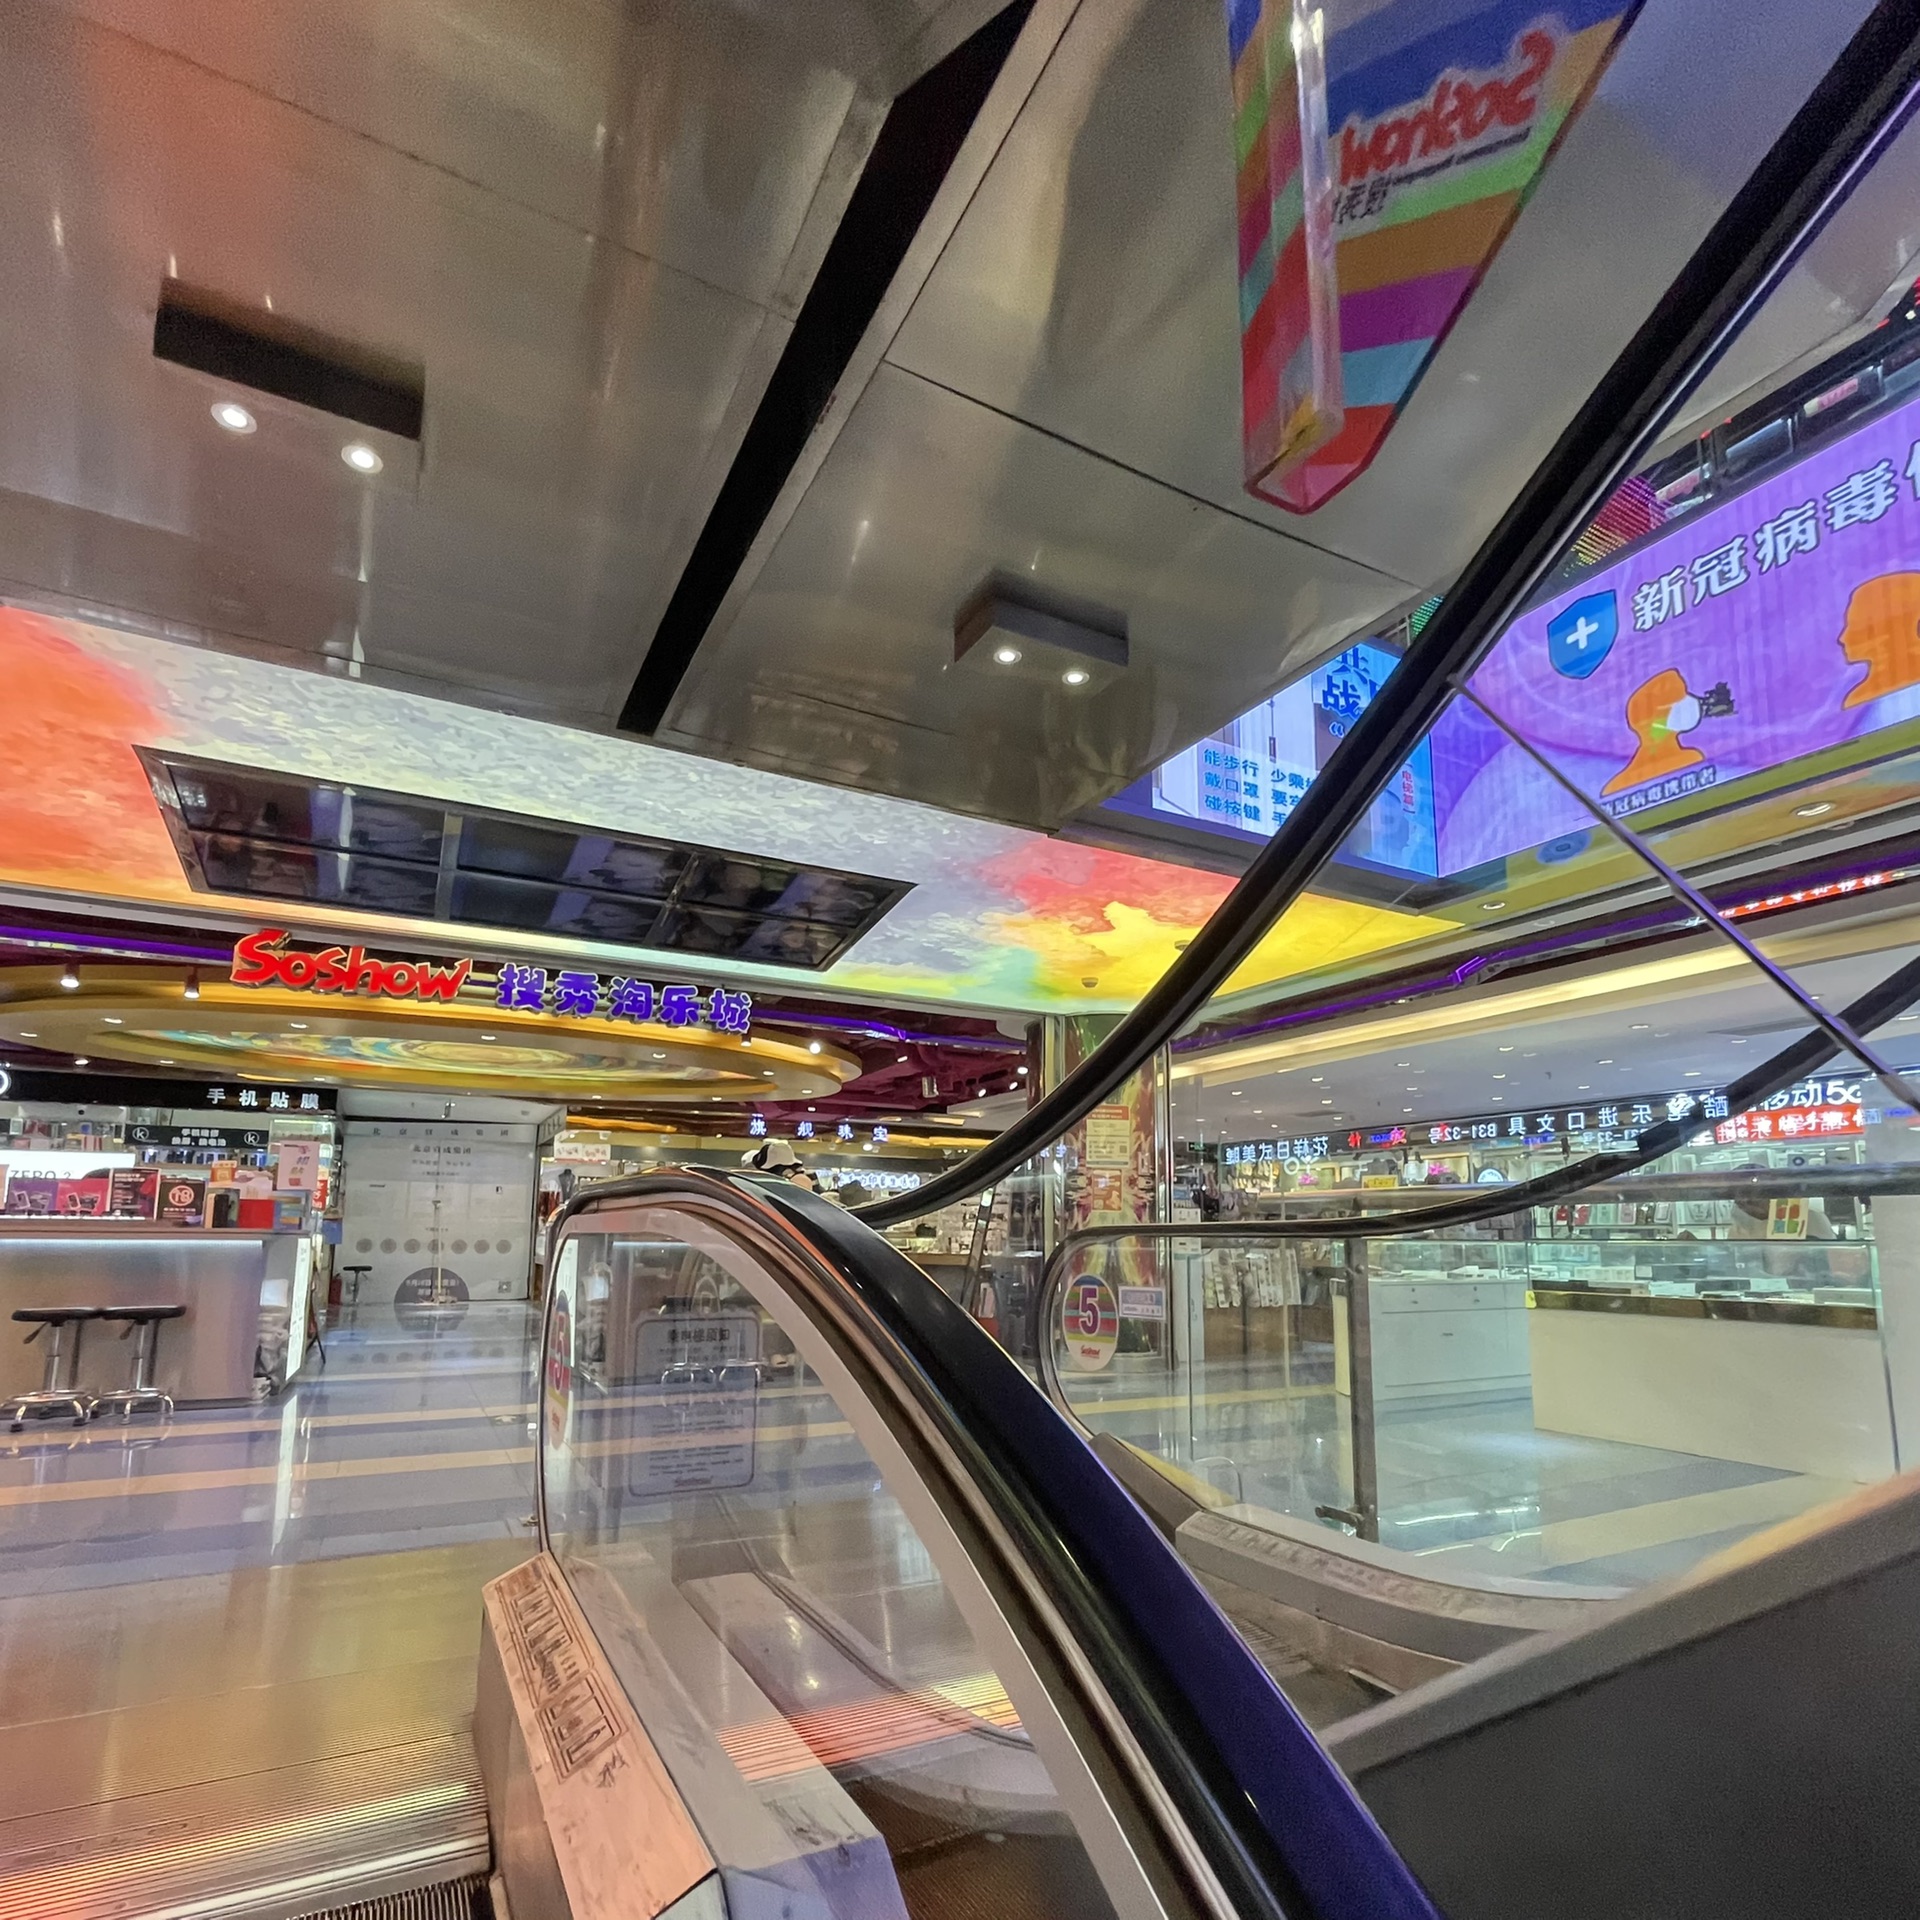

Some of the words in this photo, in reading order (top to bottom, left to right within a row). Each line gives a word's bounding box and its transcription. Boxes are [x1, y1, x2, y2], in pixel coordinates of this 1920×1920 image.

[1322, 674, 1377, 721] 战
[1204, 748, 1259, 778] 能步行
[1204, 772, 1260, 799] 戴口罩
[1204, 794, 1260, 822] 碰按键
[229, 928, 473, 1001] Soshow
[497, 962, 753, 1034] 搜秀淘乐城
[206, 1087, 319, 1110] 手机贴膜
[1748, 1081, 1862, 1112] 移动5G
[750, 1118, 889, 1142] 旗舰珠宝
[1080, 1285, 1100, 1336] 5
